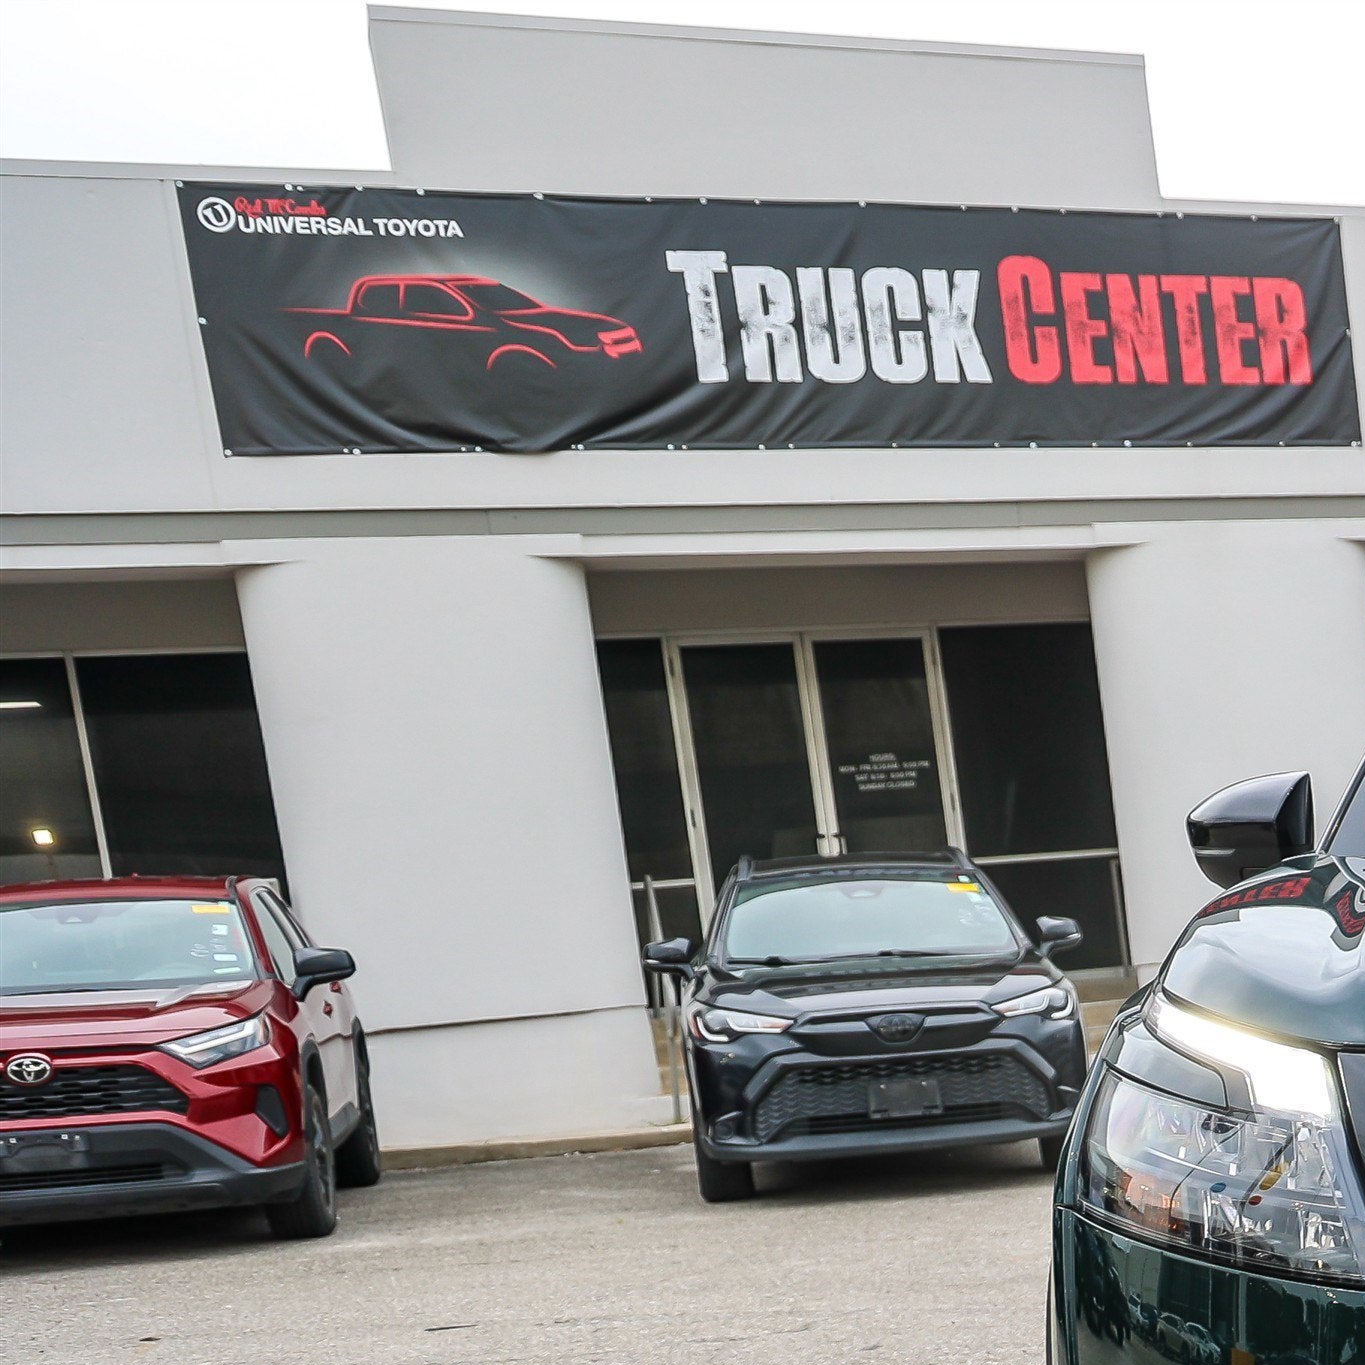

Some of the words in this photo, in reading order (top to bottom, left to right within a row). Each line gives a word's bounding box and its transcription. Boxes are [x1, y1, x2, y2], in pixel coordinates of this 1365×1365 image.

[234, 196, 264, 218] Red
[236, 215, 374, 236] UNIVERSAL
[372, 217, 465, 238] TOYOTA
